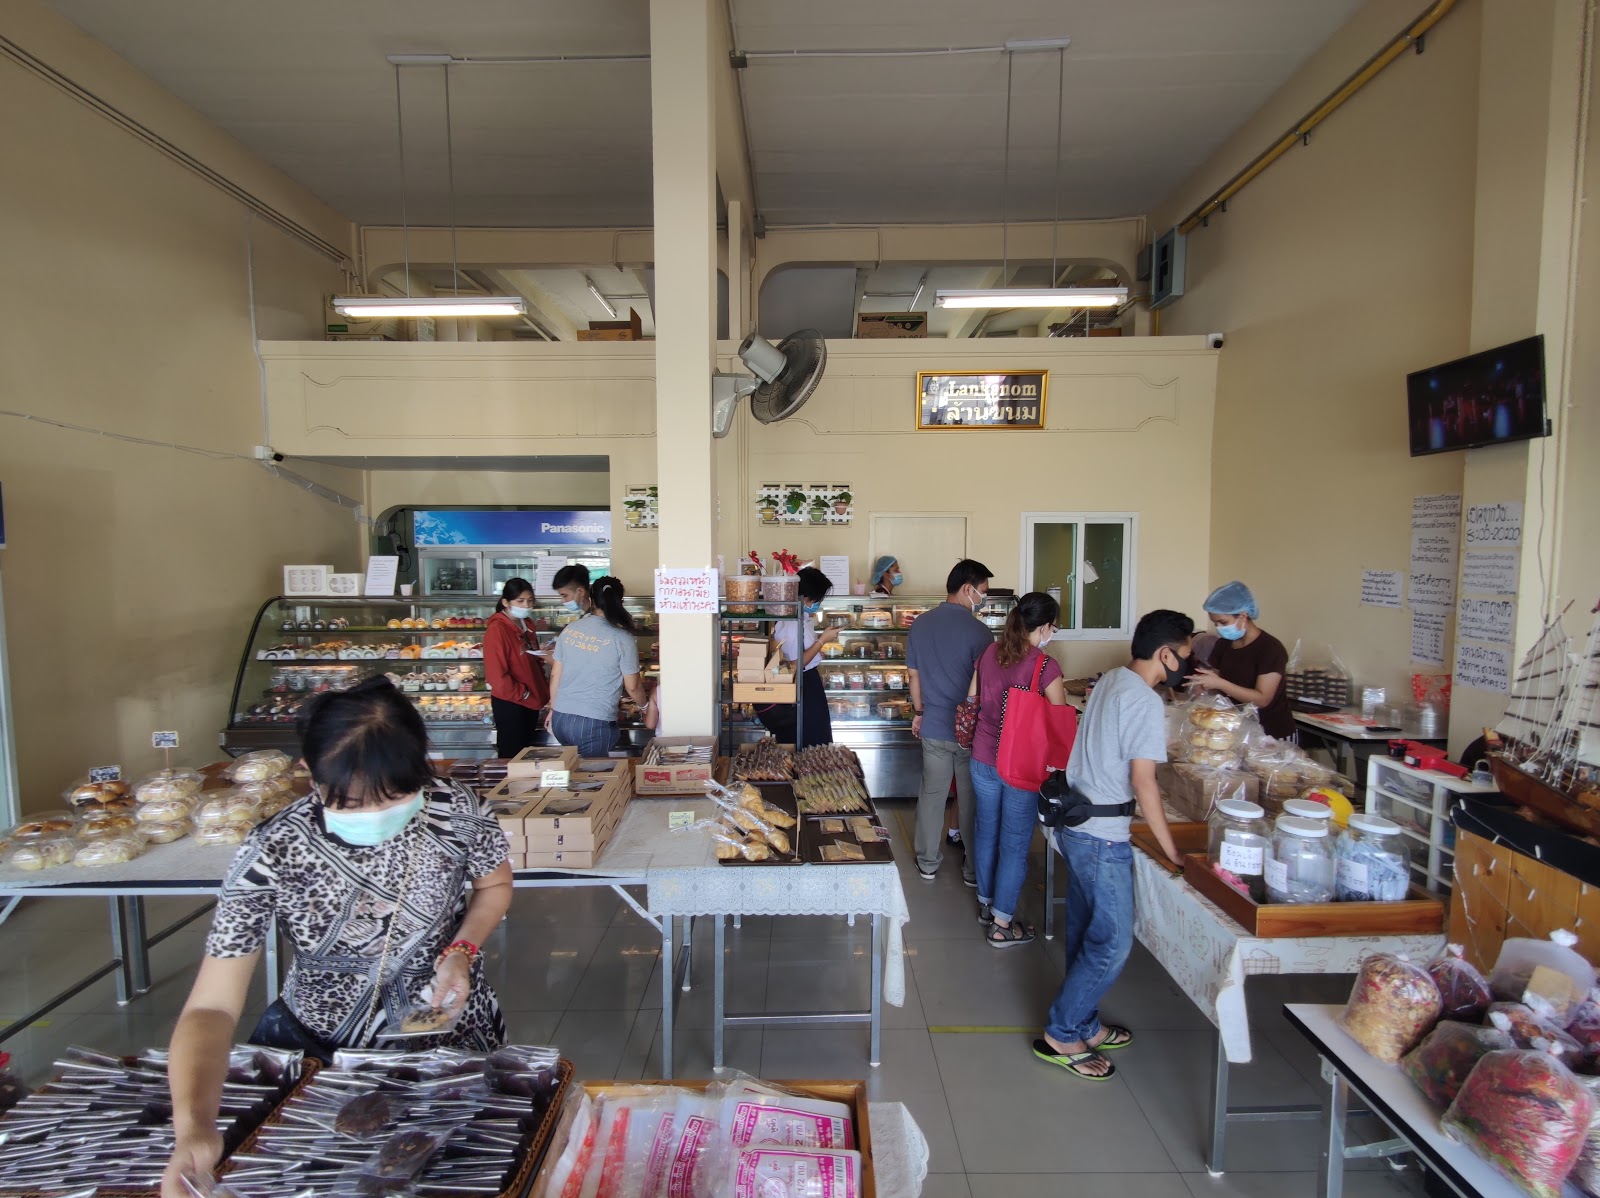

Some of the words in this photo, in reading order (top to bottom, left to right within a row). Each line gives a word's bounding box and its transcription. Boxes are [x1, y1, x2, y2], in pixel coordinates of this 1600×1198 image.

[541, 522, 604, 533] Panasonic
[659, 586, 710, 598] กากอนามัย
